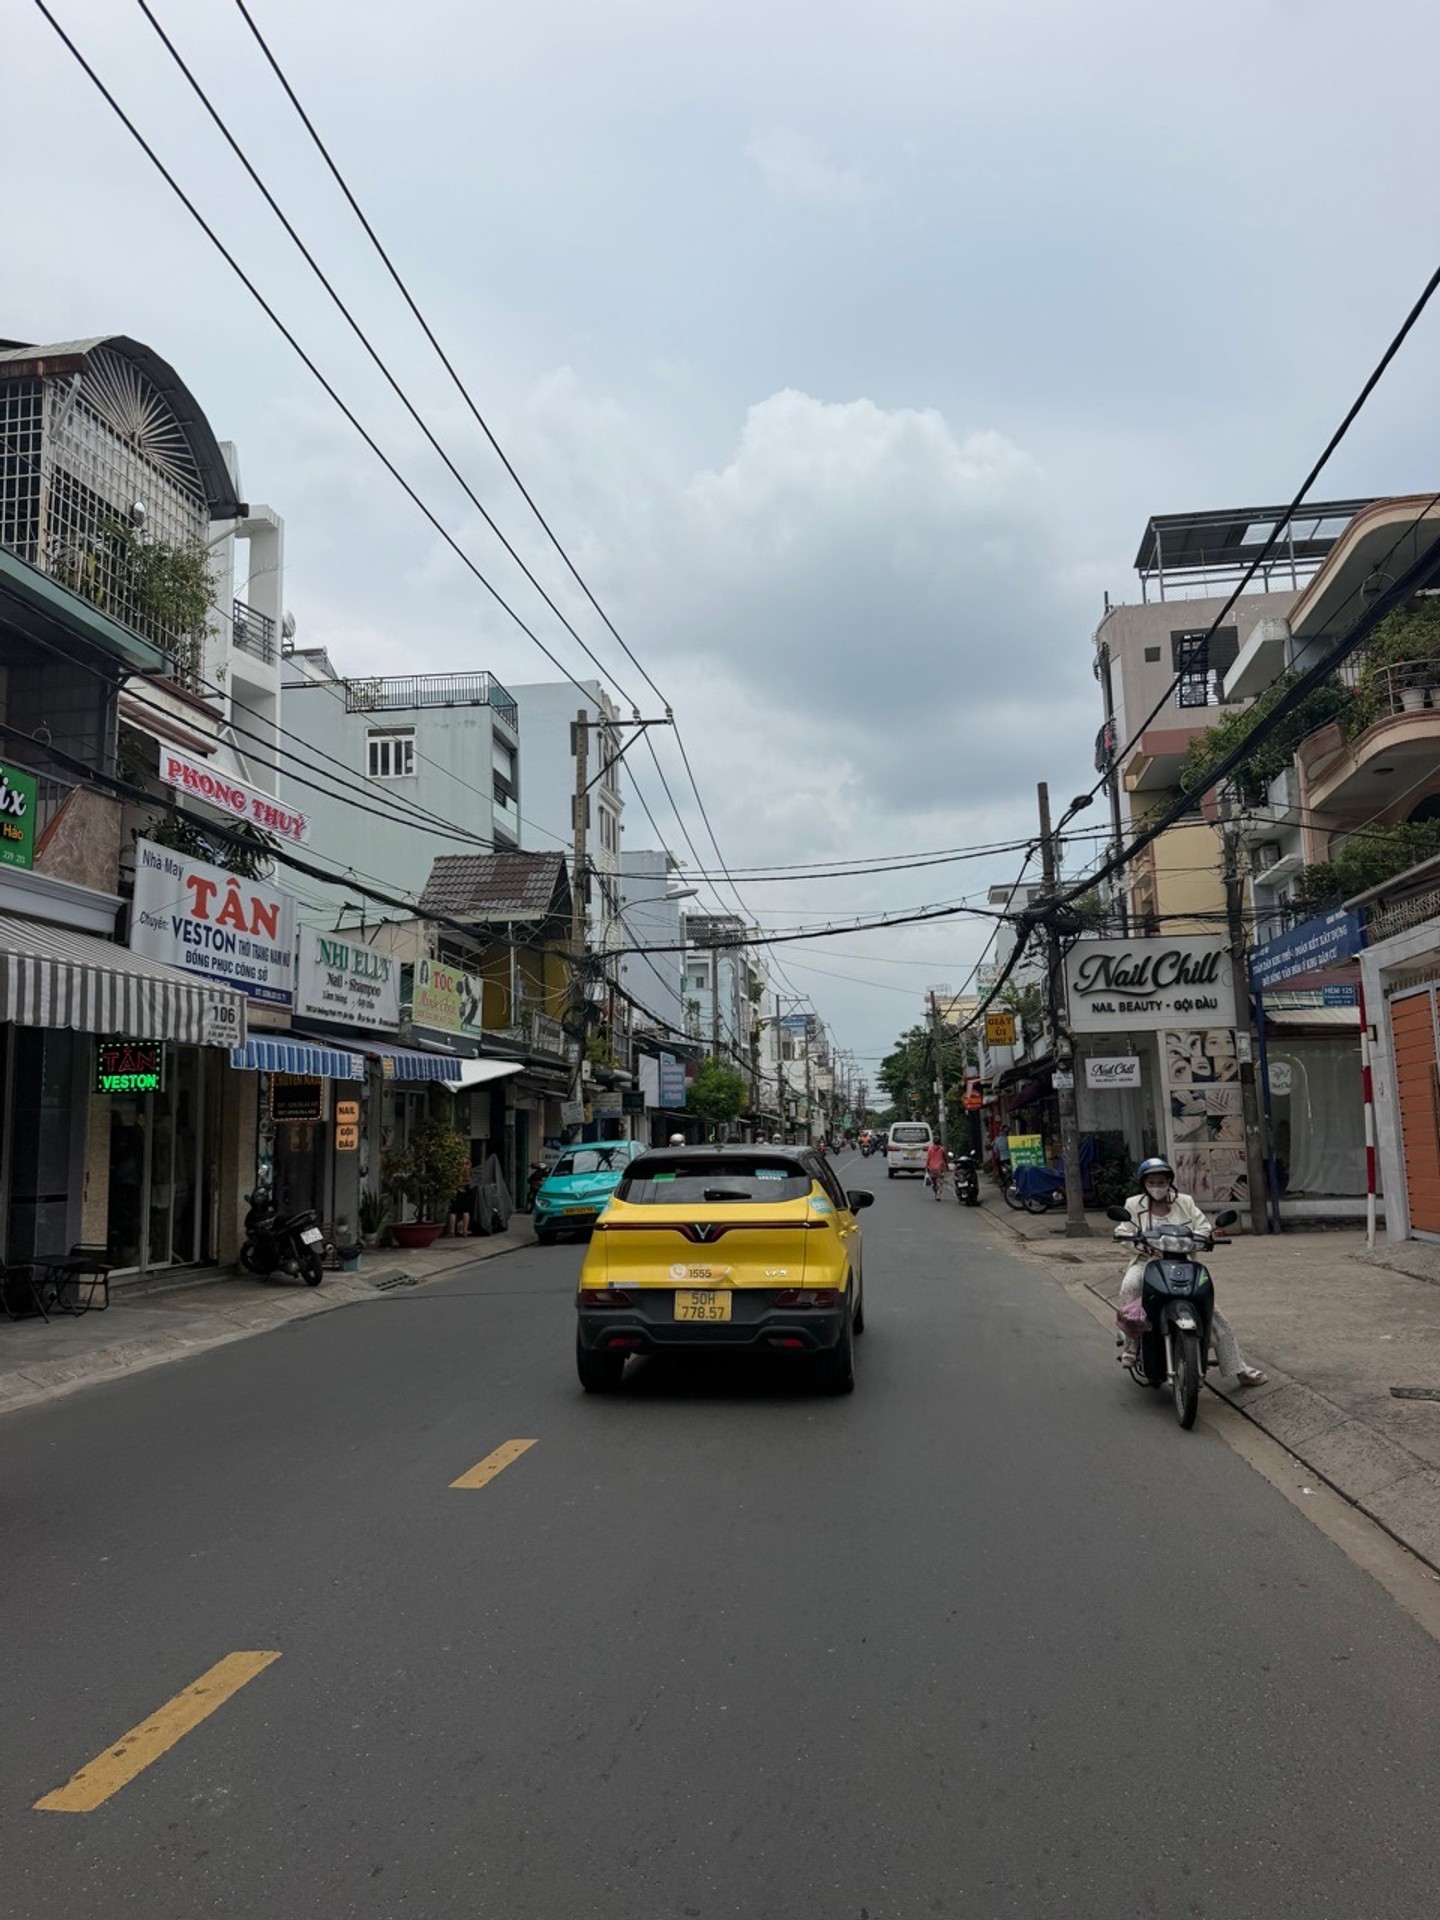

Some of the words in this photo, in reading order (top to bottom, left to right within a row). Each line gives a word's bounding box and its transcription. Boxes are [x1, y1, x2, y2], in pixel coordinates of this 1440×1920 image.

[167, 756, 247, 812] PHONG
[142, 848, 162, 870] Nhà
[165, 857, 184, 881] May
[186, 873, 280, 941] TÂN
[171, 914, 237, 955] VESTON
[316, 937, 349, 972] NHI
[351, 948, 392, 982] ELLY
[1073, 952, 1152, 993] Nail
[1152, 950, 1222, 989] Chill
[212, 1006, 236, 1024] 106
[1092, 1002, 1116, 1013] NAIL
[1119, 1000, 1163, 1013] BEAUTY
[1174, 997, 1193, 1013] GỘI
[103, 1045, 157, 1073] TÂN
[102, 1073, 157, 1090] VESTON
[339, 1106, 356, 1115] NAIL
[689, 1269, 712, 1279] 1555
[691, 1292, 716, 1305] 50H
[682, 1306, 725, 1320] 778.57
